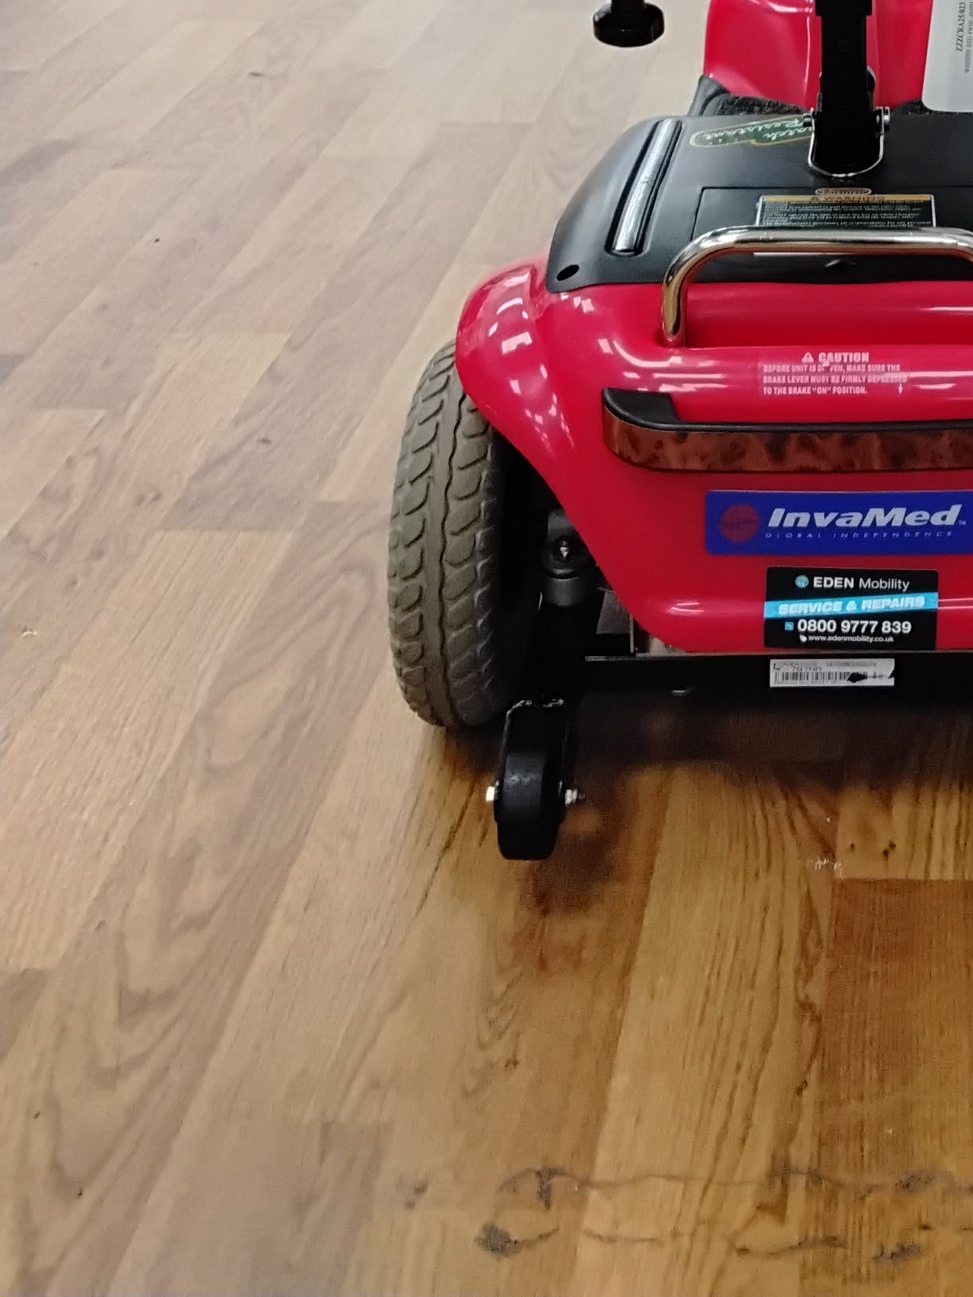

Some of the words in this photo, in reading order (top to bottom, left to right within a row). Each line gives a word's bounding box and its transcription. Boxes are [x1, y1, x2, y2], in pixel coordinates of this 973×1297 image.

[818, 352, 870, 362] CAUTION
[763, 364, 790, 372] BEFORE
[791, 364, 808, 372] UNIT
[810, 364, 816, 372] IS
[846, 364, 866, 372] MAKE
[867, 364, 885, 372] SURE
[887, 364, 900, 372] THE
[763, 375, 786, 383] BRAKE
[787, 375, 809, 383] LEVER
[811, 375, 829, 383] MUST
[830, 375, 840, 383] BE
[841, 375, 866, 383] FIRMLY
[763, 386, 772, 394] TO
[774, 386, 787, 394] THE
[788, 386, 811, 394] BRAKE
[832, 386, 867, 394] POSITION.
[767, 504, 962, 527] InvaMed
[813, 576, 854, 588] EDEN
[858, 578, 910, 592] Mobility
[778, 601, 843, 615] SERVICE
[846, 600, 857, 612] &
[861, 596, 925, 610] REPAIRS
[797, 619, 836, 632] 0800
[841, 620, 879, 633] 9777
[881, 620, 912, 634] 839
[808, 635, 894, 643] www.edenmobility.co.uk
